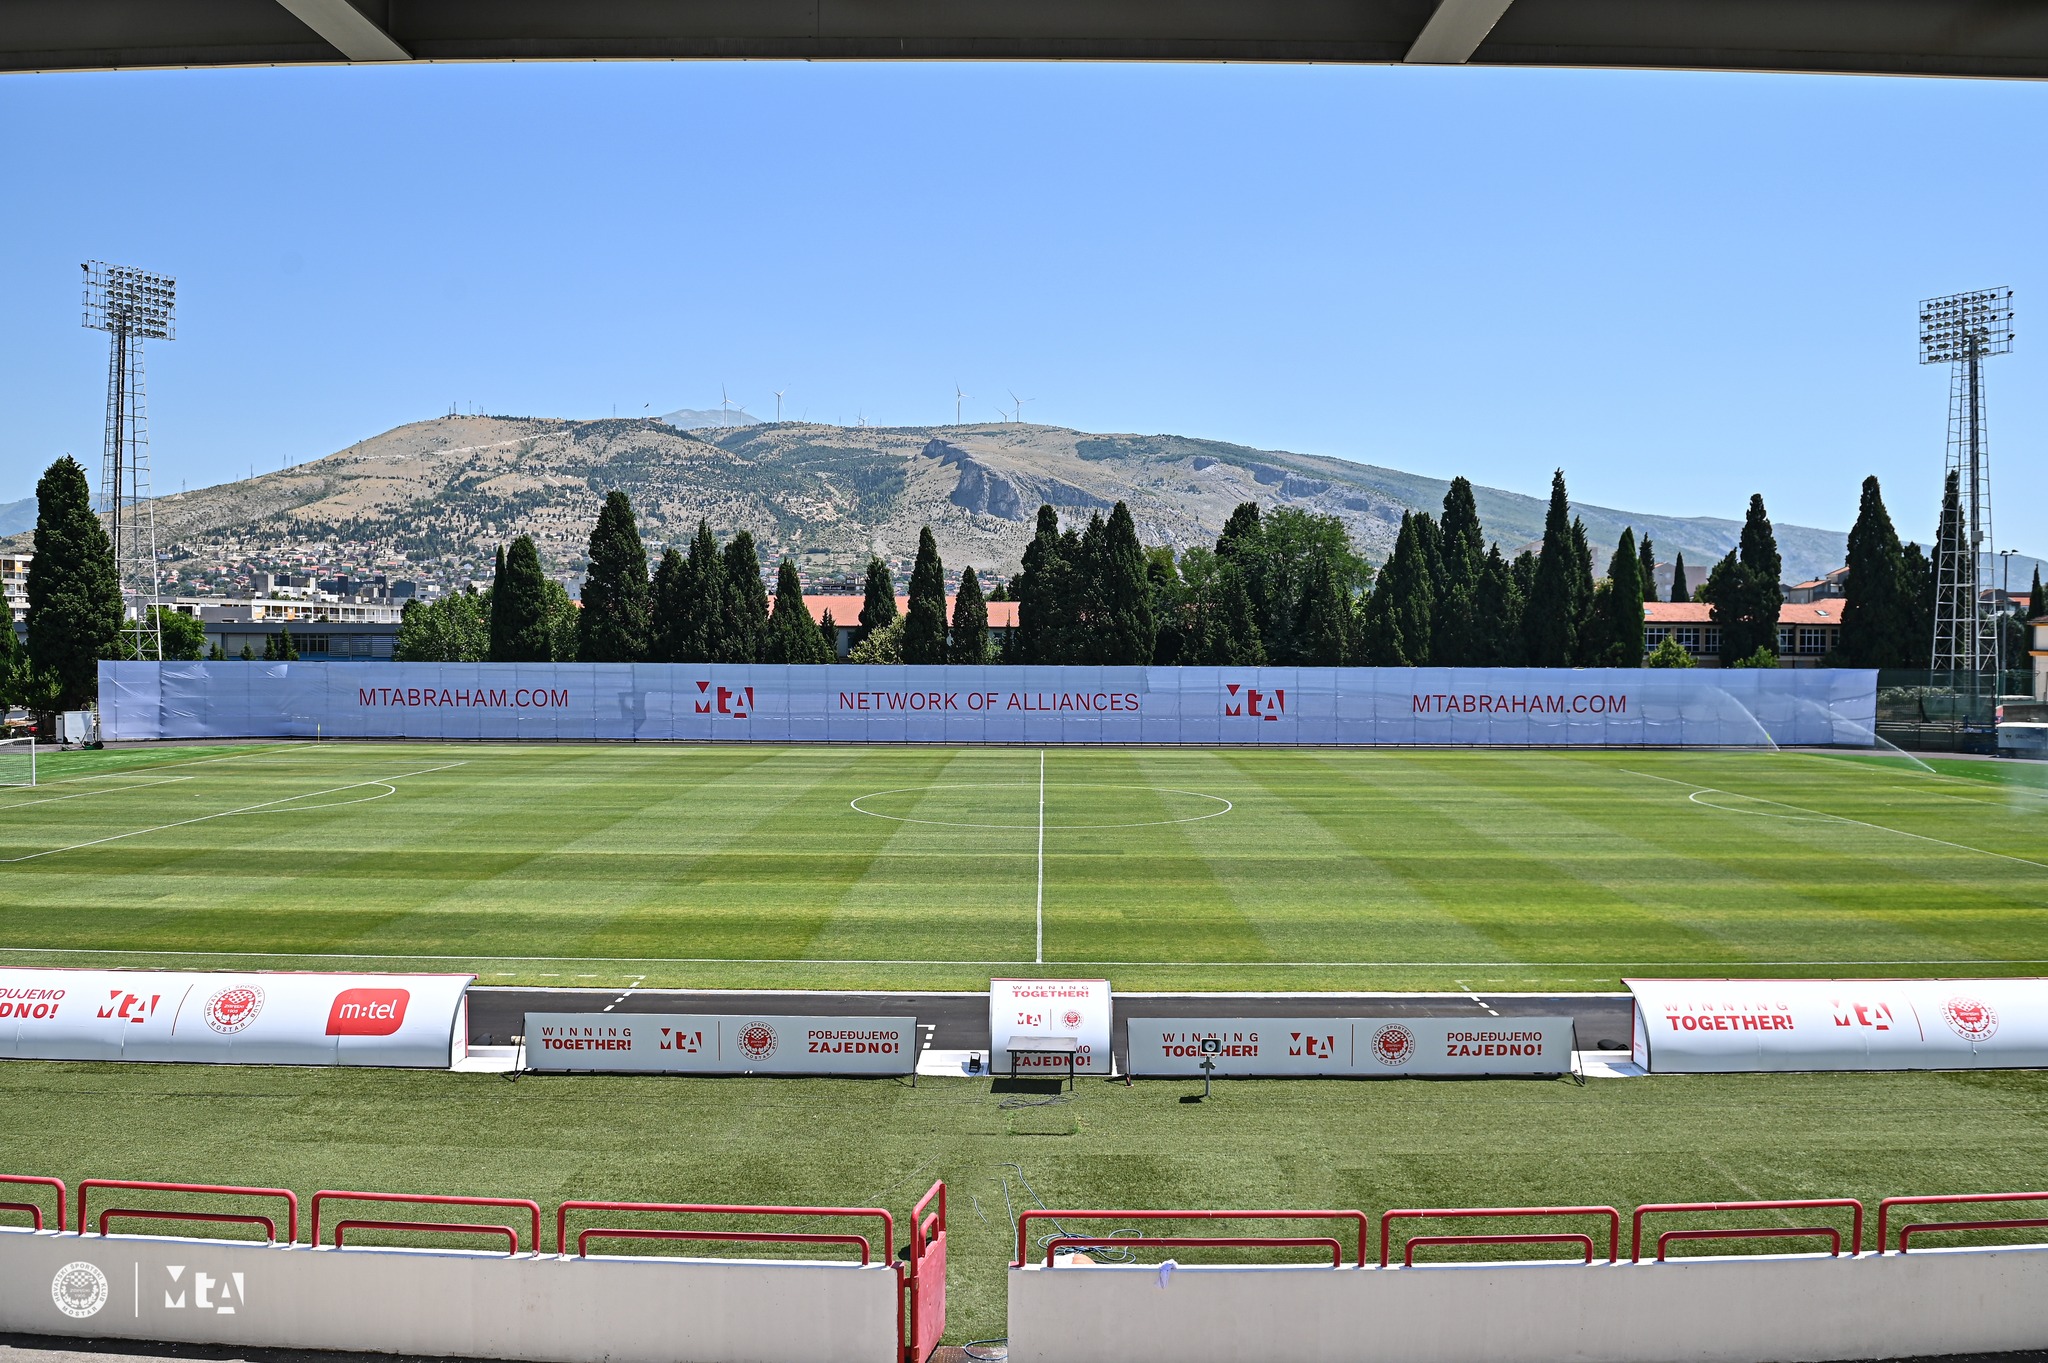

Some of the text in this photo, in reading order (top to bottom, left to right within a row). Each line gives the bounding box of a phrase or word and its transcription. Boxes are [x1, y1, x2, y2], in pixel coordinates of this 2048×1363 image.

[359, 689, 569, 708] MTABRAHAM.COM
[839, 691, 1140, 712] NETWORK OF ALLIANCES
[1413, 694, 1627, 713] MTABRAHAM.COM
[339, 999, 398, 1020] m:tel
[1664, 1000, 1789, 1011] WINNING
[210, 1020, 246, 1032] MOSTAR
[1666, 1015, 1795, 1031] TOGETHER!
[542, 1027, 631, 1037] WINNING
[808, 1030, 899, 1040] POBJEĐUJEMO
[1447, 1032, 1542, 1042] POBJEĐUJEMO
[1957, 1029, 1993, 1039] MOSTAR
[542, 1038, 631, 1050] TOGETHER!
[808, 1042, 899, 1054] ZAJEDNO!
[1447, 1044, 1542, 1056] ZAJEDNO!
[745, 1052, 770, 1060] MOSTAR
[1379, 1057, 1406, 1065] MOSTAR
